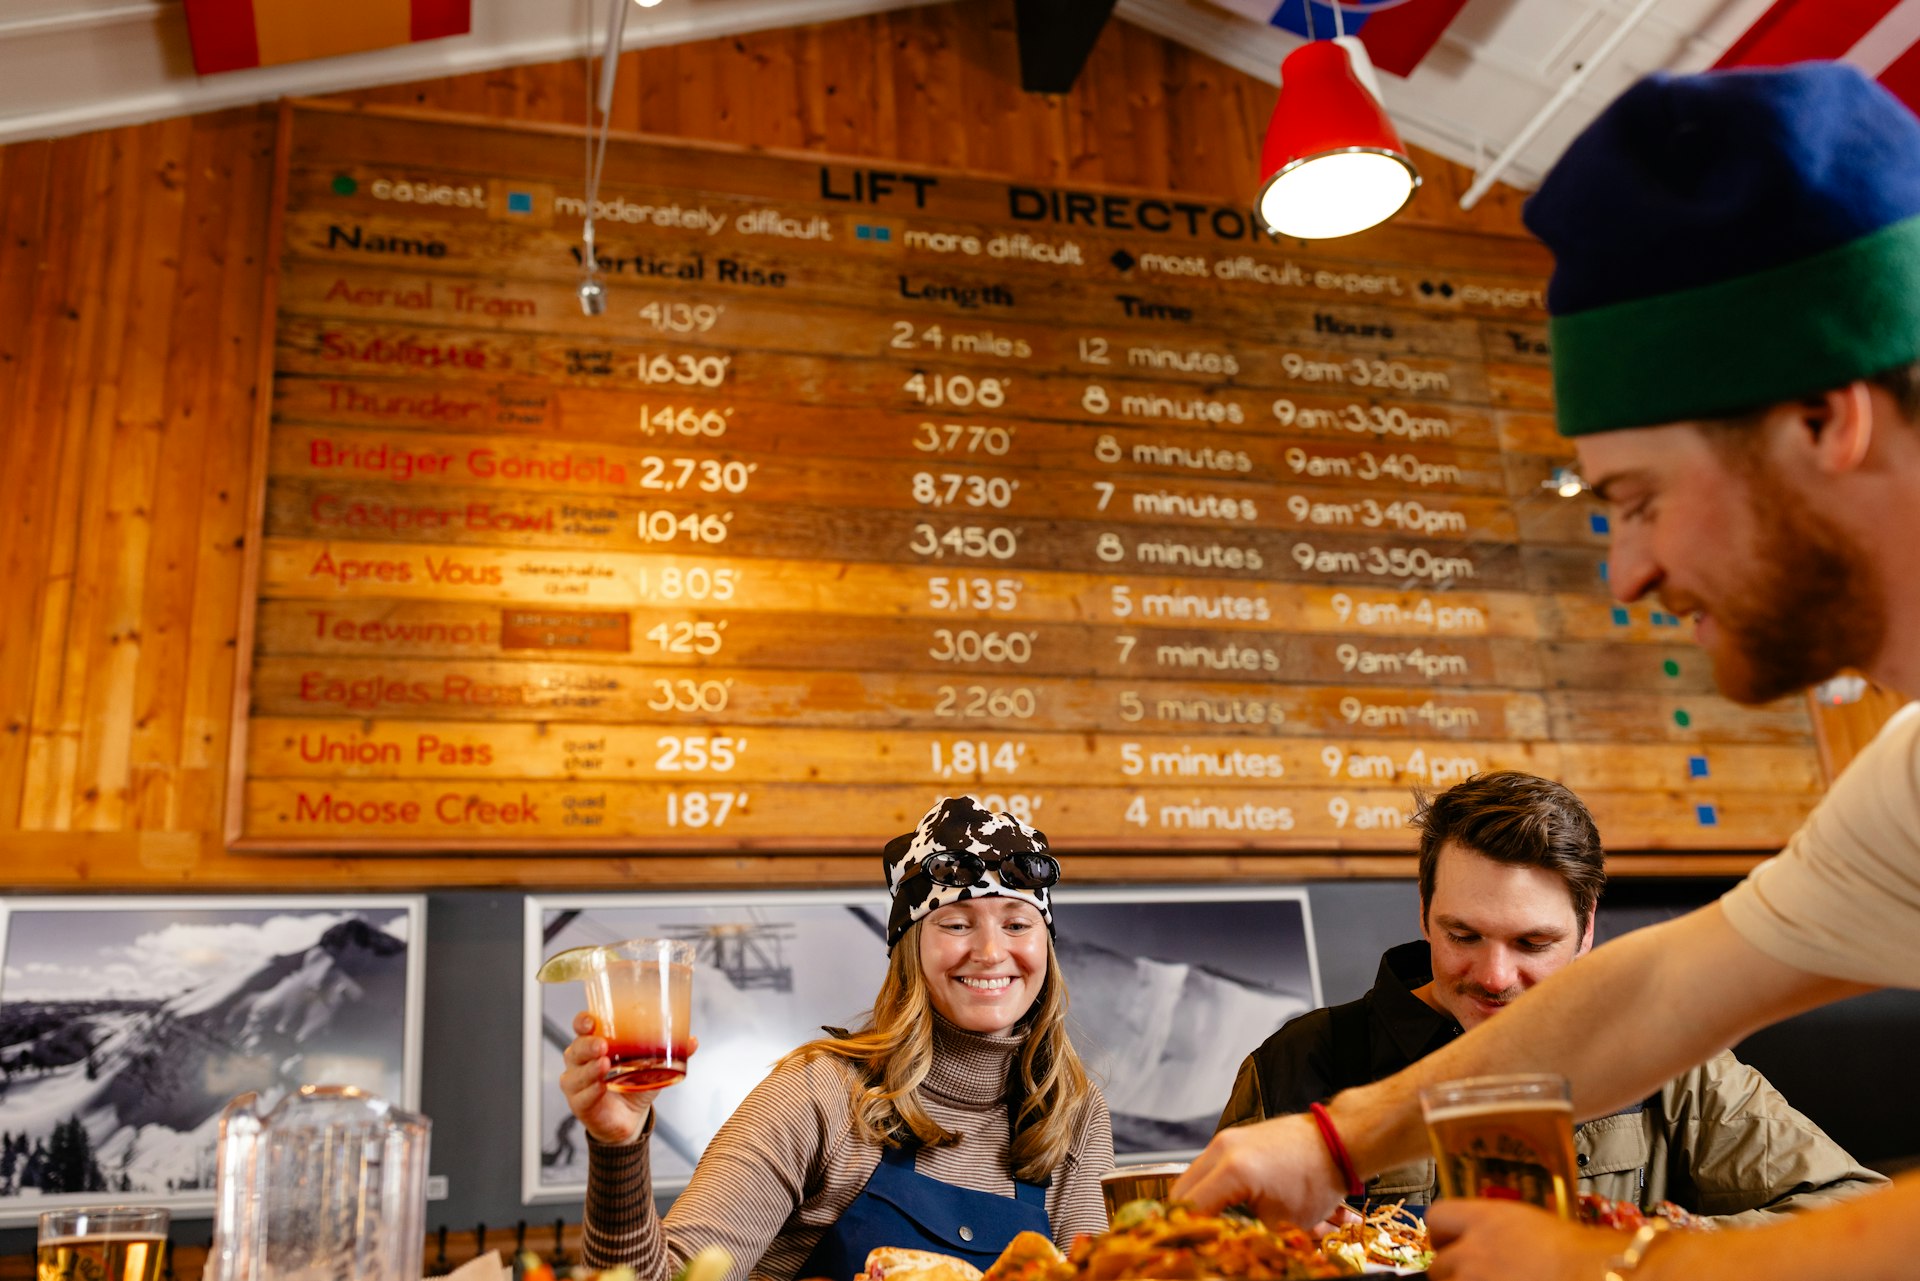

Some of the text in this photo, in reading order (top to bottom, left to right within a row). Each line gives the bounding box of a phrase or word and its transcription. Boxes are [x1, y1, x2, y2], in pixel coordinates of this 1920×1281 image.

[371, 179, 487, 210] easiest
[820, 166, 938, 208] LIFT
[555, 196, 834, 242] moderately difficult
[327, 225, 447, 259] Name
[903, 228, 1084, 266] more difficult
[570, 245, 788, 288] Vertical Rise
[1140, 251, 1210, 277] most
[325, 278, 537, 317] Aerial Tram
[899, 275, 1014, 309] Length
[1115, 294, 1192, 322] Time
[1460, 284, 1546, 310] expert
[952, 330, 1032, 358] miles
[1314, 313, 1395, 340] Hours
[1079, 337, 1240, 376] 12 minutes
[320, 382, 481, 422] Thunder
[1081, 385, 1244, 425] 8 minutes
[309, 438, 628, 485] Bridger Gondola
[1095, 434, 1253, 473] 8 minutes
[640, 456, 757, 493] 2,730'
[912, 472, 1020, 508] 8,730'
[309, 494, 555, 533] Casper Bowl
[1092, 481, 1258, 522] 7 minutes
[309, 551, 505, 588] Apres Vous
[1096, 533, 1264, 571] 8 minutes
[929, 577, 1023, 612] 5,135'
[1110, 586, 1271, 622] 5 minutes
[307, 609, 490, 645] Teewinot
[646, 620, 728, 655] 425'
[1115, 636, 1280, 672] 7 minutes
[300, 671, 432, 709] Eagles
[647, 678, 734, 713] 330'
[1119, 691, 1285, 725] 5 minutes
[300, 734, 493, 766] Union Pass
[655, 736, 746, 771] 255'
[931, 741, 1025, 778] 1,814'
[1121, 743, 1284, 779] 5 minutes
[295, 792, 540, 826] Moose Creek
[667, 793, 748, 828] 187'
[1125, 795, 1295, 831] 4 minutes
